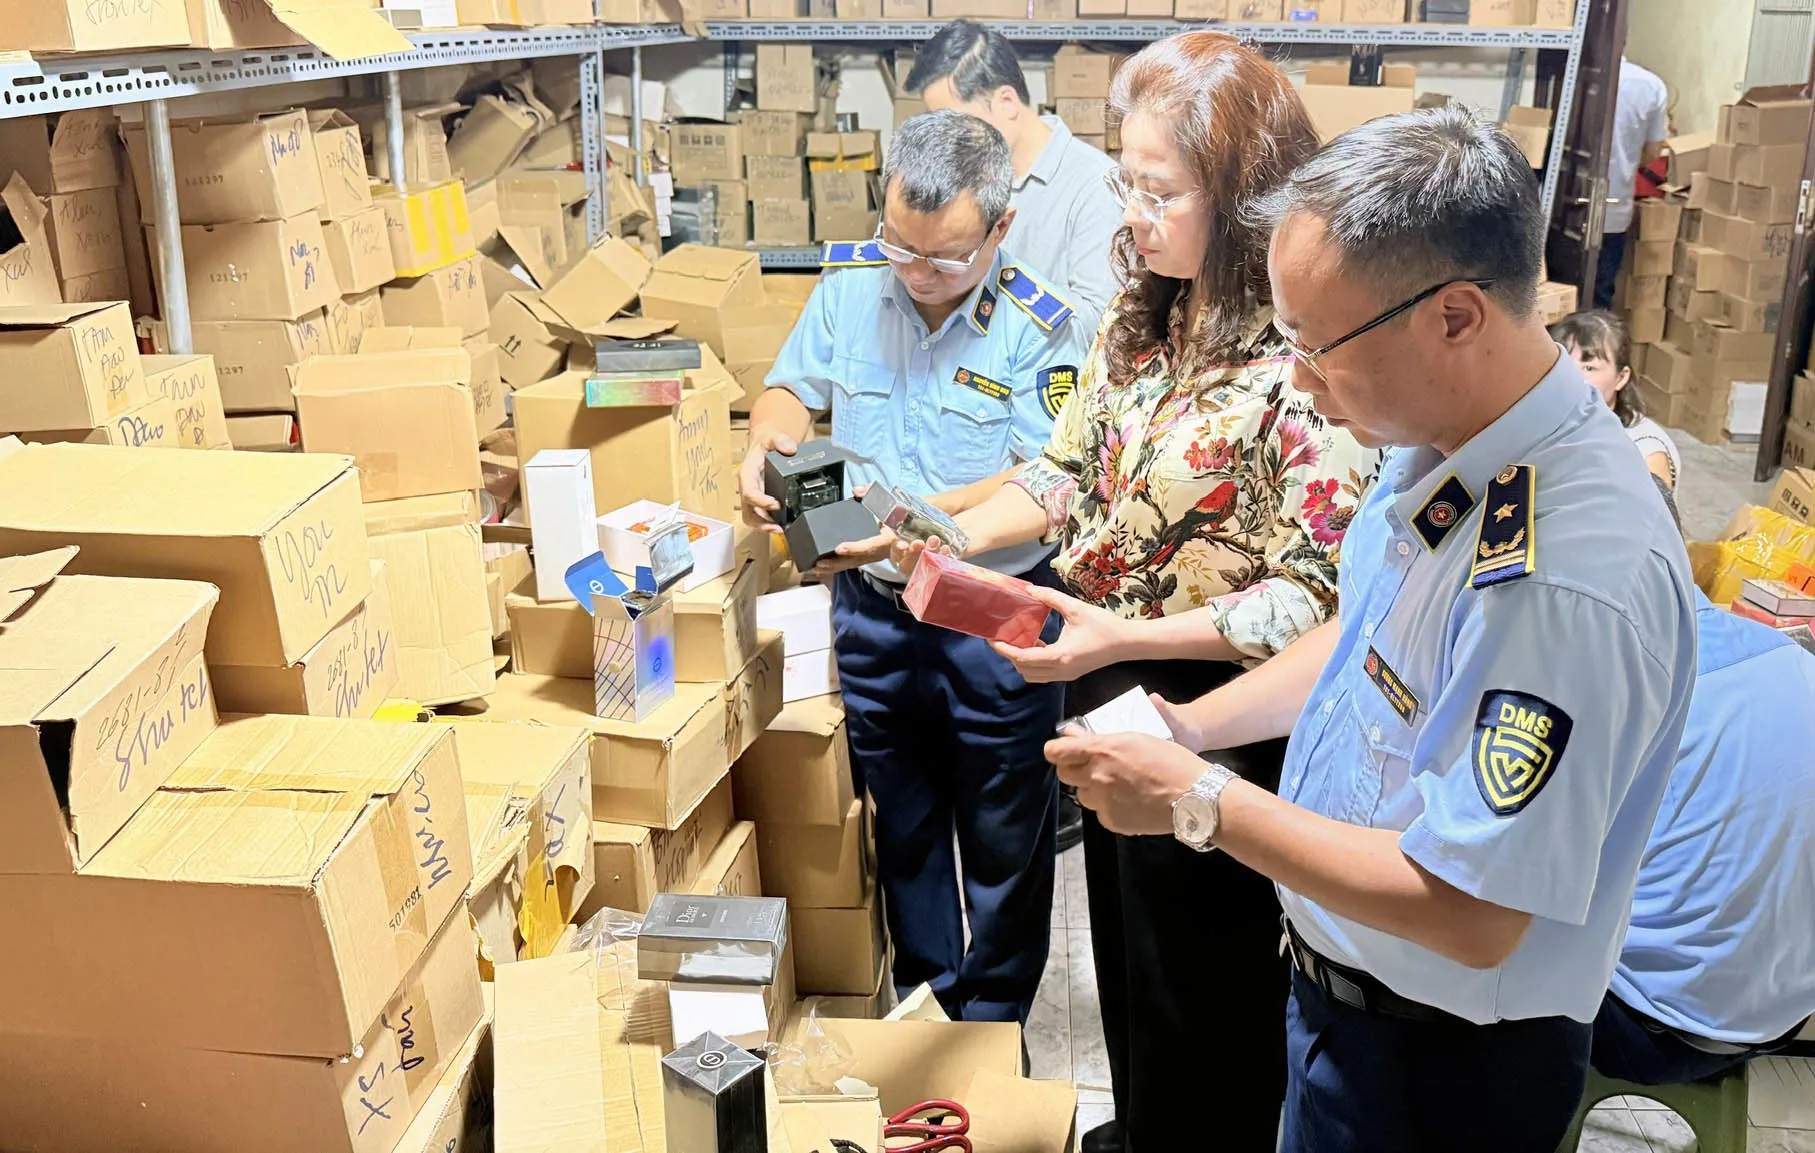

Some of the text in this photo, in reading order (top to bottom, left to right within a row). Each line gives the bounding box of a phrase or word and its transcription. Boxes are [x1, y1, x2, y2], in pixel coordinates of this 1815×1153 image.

[1049, 371, 1073, 384] DMS
[1499, 702, 1553, 739] DMS
[676, 904, 695, 922] Dior
